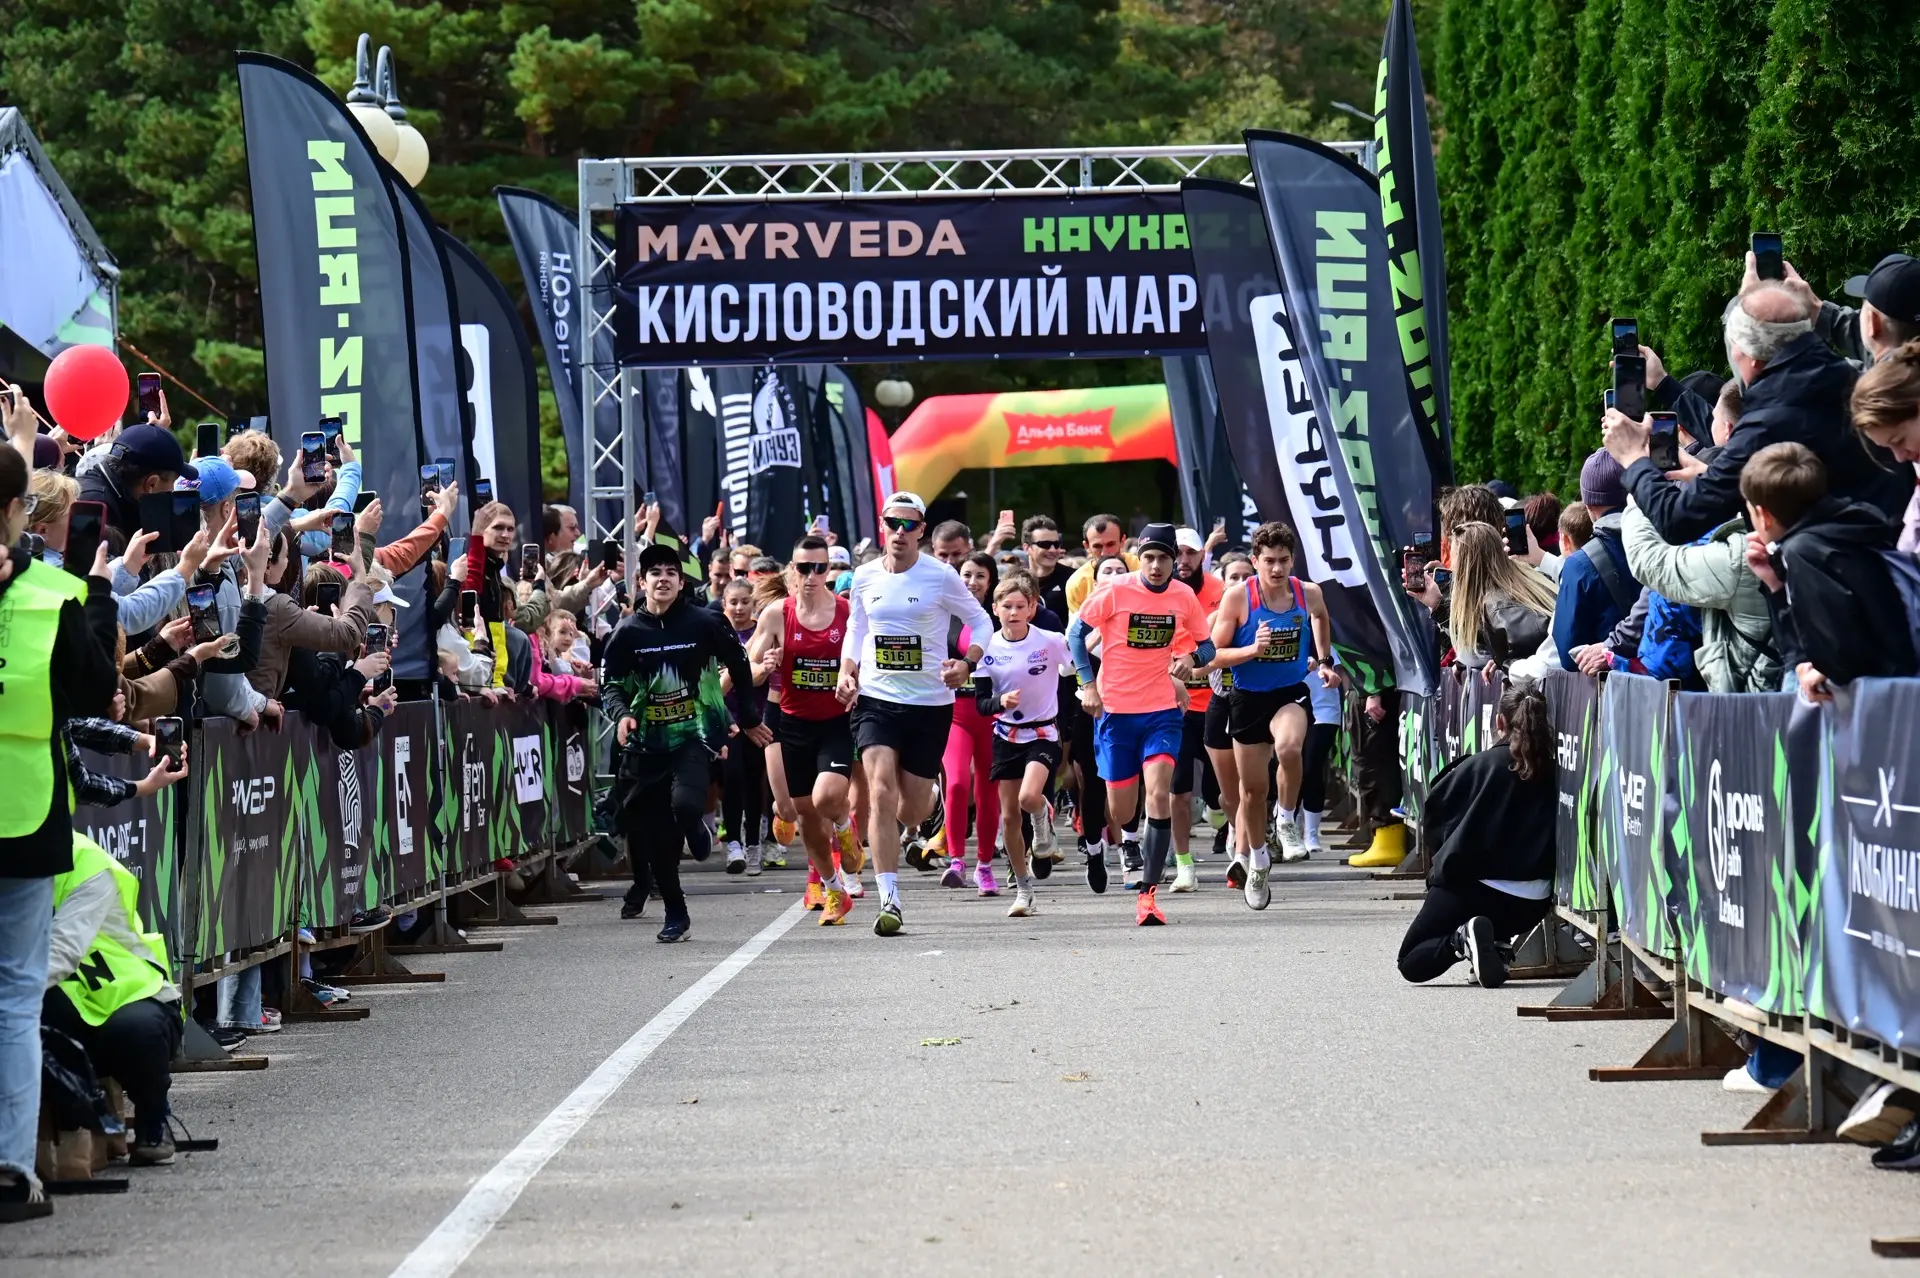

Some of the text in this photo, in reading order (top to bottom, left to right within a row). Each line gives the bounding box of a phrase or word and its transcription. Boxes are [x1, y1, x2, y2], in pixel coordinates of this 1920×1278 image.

[637, 220, 967, 262] MAYRVEDA
[638, 264, 1069, 347] КИСЛОВОДСКИЙ
[1016, 422, 1103, 442] Альфа Банк
[1137, 629, 1167, 640] 5217
[634, 642, 697, 654] ГОРЫ ЗОВУТ
[1264, 645, 1293, 656] 5200
[882, 650, 912, 662] 5161
[801, 670, 831, 683] 5061
[654, 703, 688, 718] 5142
